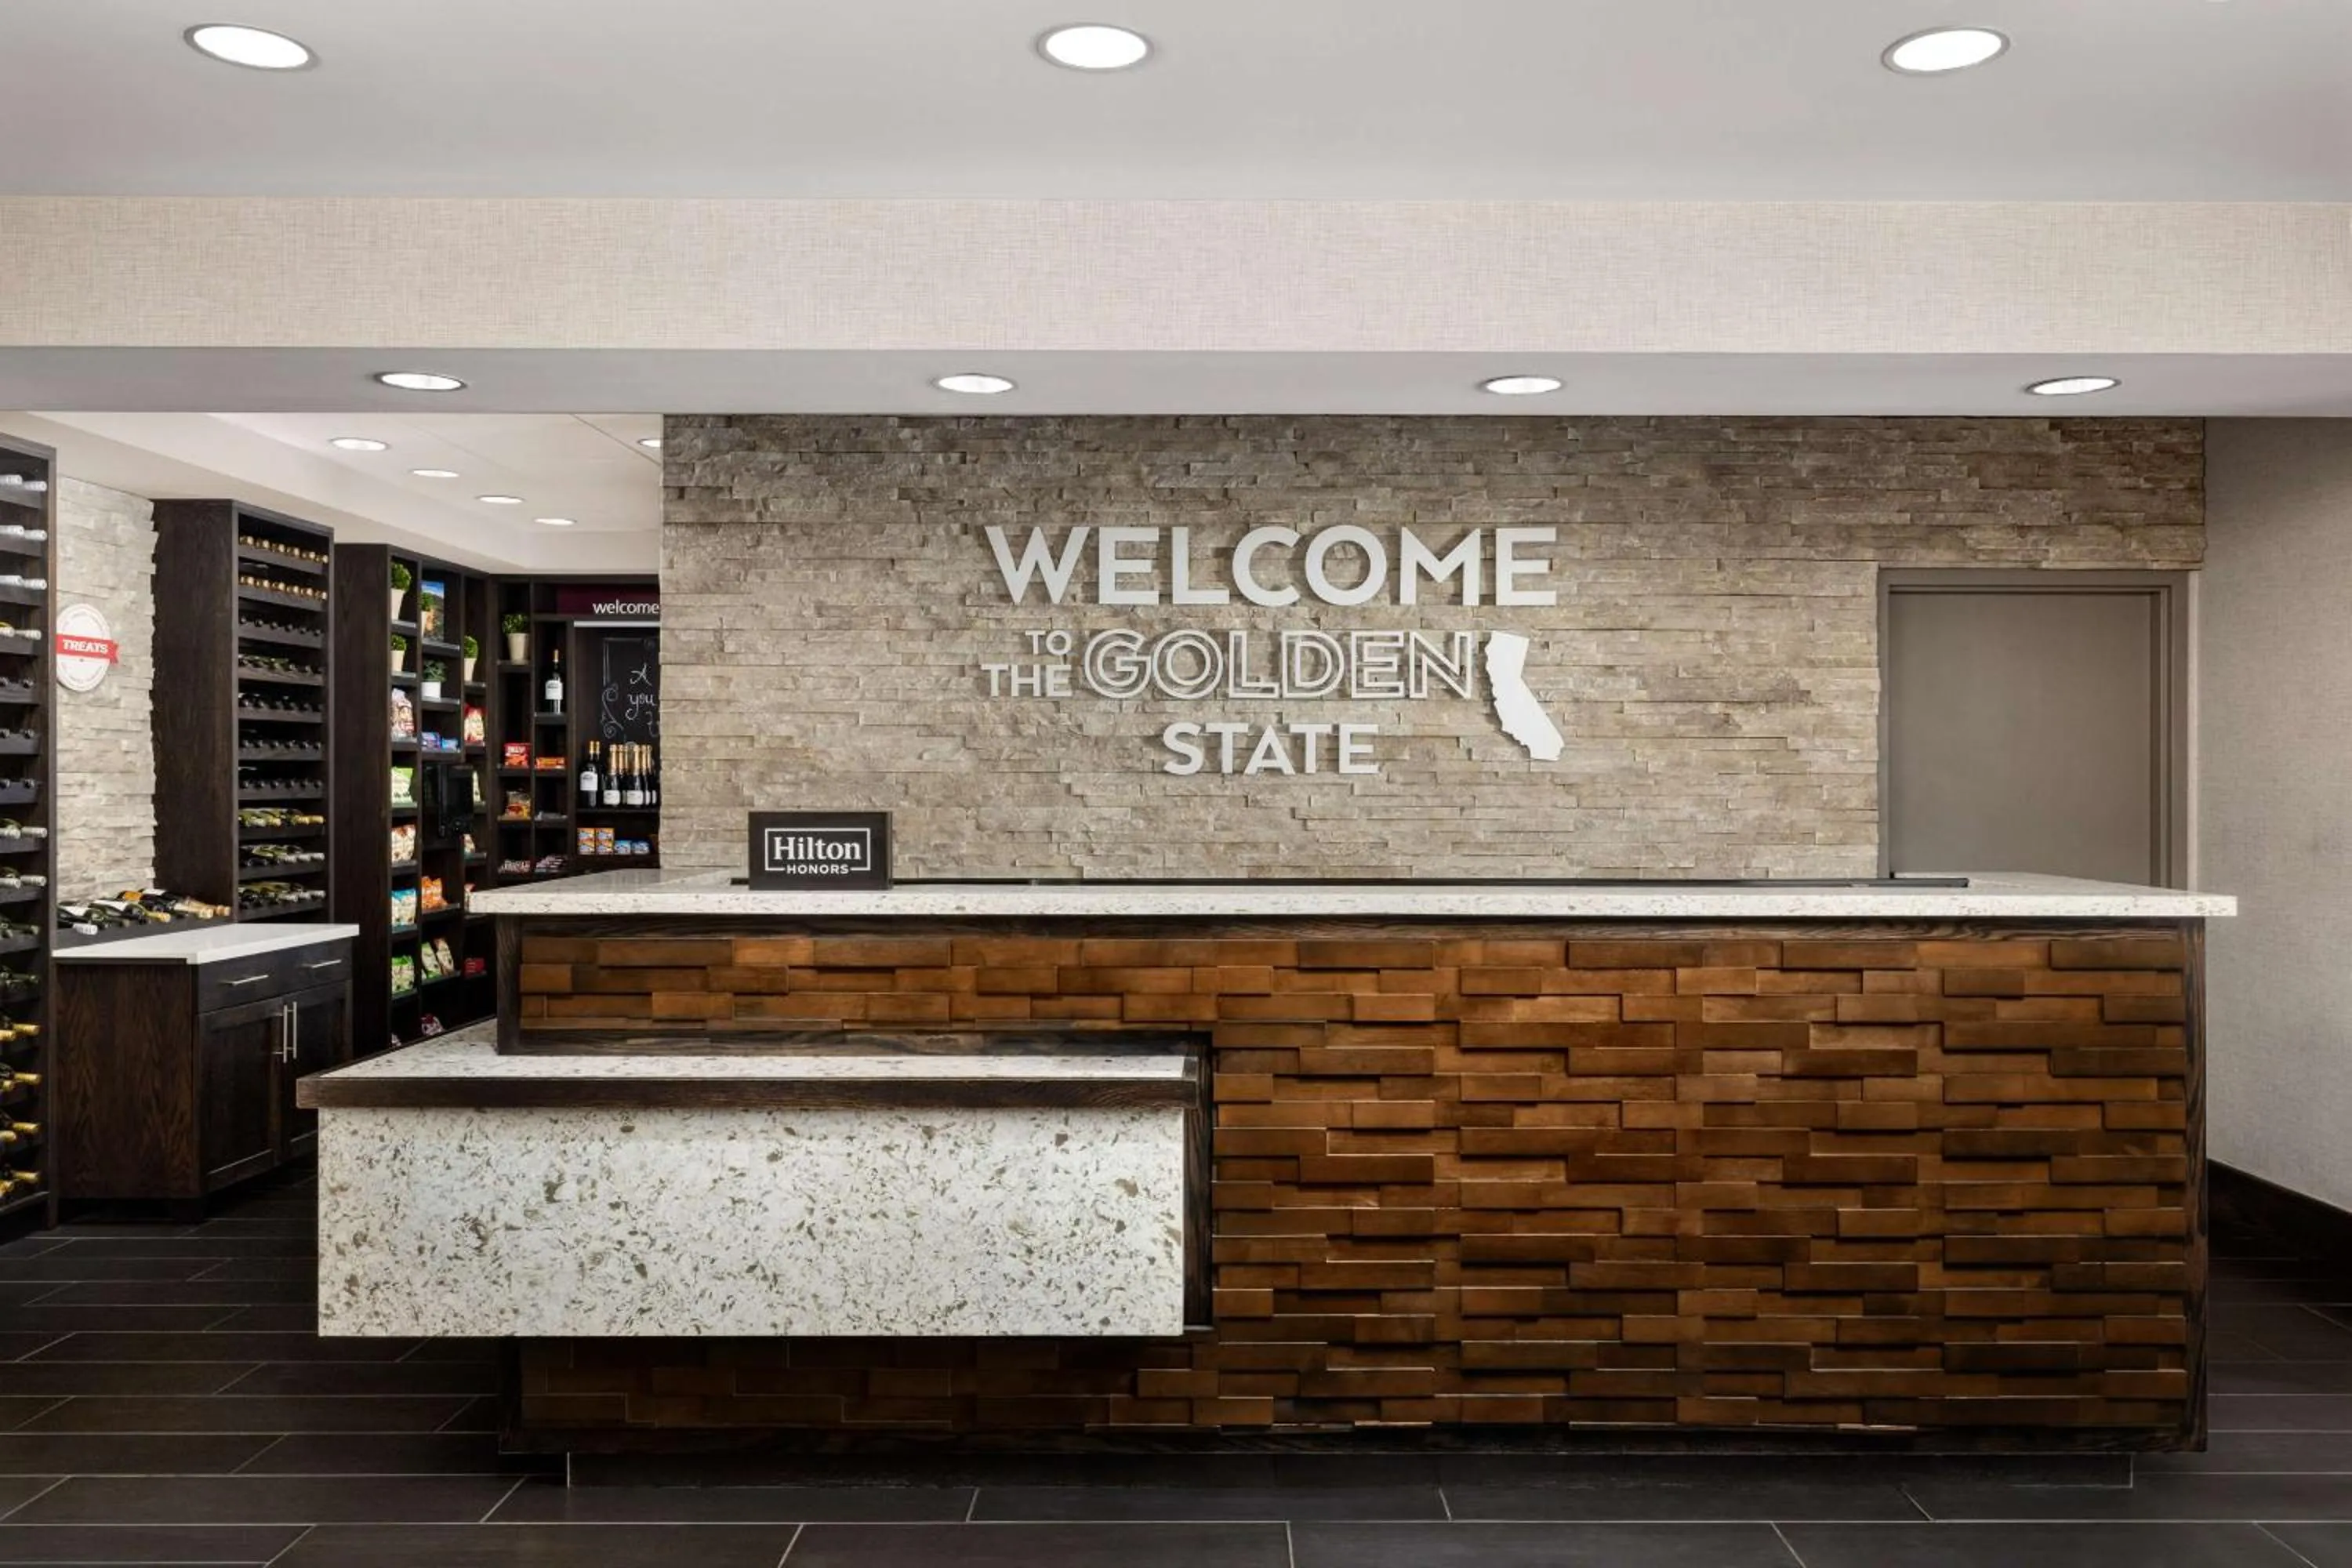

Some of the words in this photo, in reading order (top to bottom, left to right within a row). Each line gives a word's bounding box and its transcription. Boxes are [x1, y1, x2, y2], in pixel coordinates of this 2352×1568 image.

[983, 524, 1558, 607] WELCOME
[592, 599, 659, 615] welcome
[62, 638, 109, 655] TREATS
[1025, 630, 1072, 655] TO
[982, 663, 1073, 698] THE
[1083, 630, 1474, 700] GOLDEN
[1163, 722, 1380, 775] STATE
[773, 837, 862, 860] Hilton
[786, 864, 849, 875] HONORS
